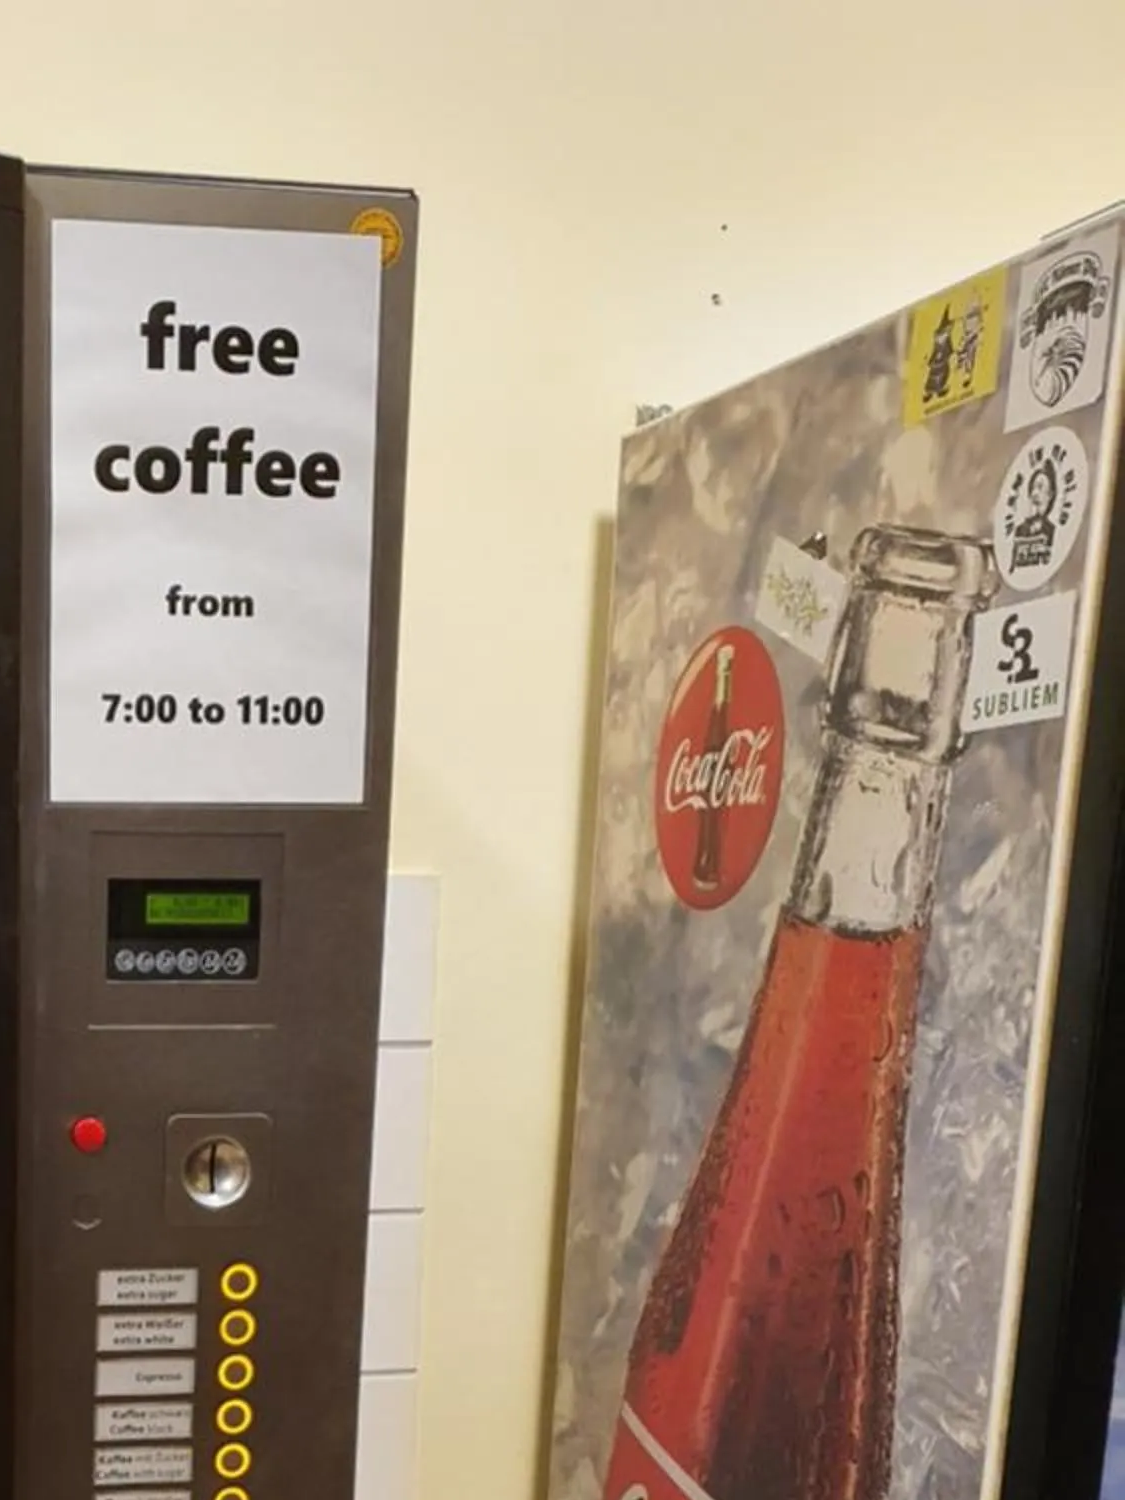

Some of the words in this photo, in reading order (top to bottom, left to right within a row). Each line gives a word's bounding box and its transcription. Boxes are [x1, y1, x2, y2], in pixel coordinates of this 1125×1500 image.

[140, 300, 300, 376] free
[94, 427, 341, 499] coffee
[166, 585, 255, 618] from
[101, 693, 177, 724] 7:00
[188, 697, 225, 725] to
[237, 695, 325, 726] 11:00
[972, 681, 1059, 721] SUBLIEM
